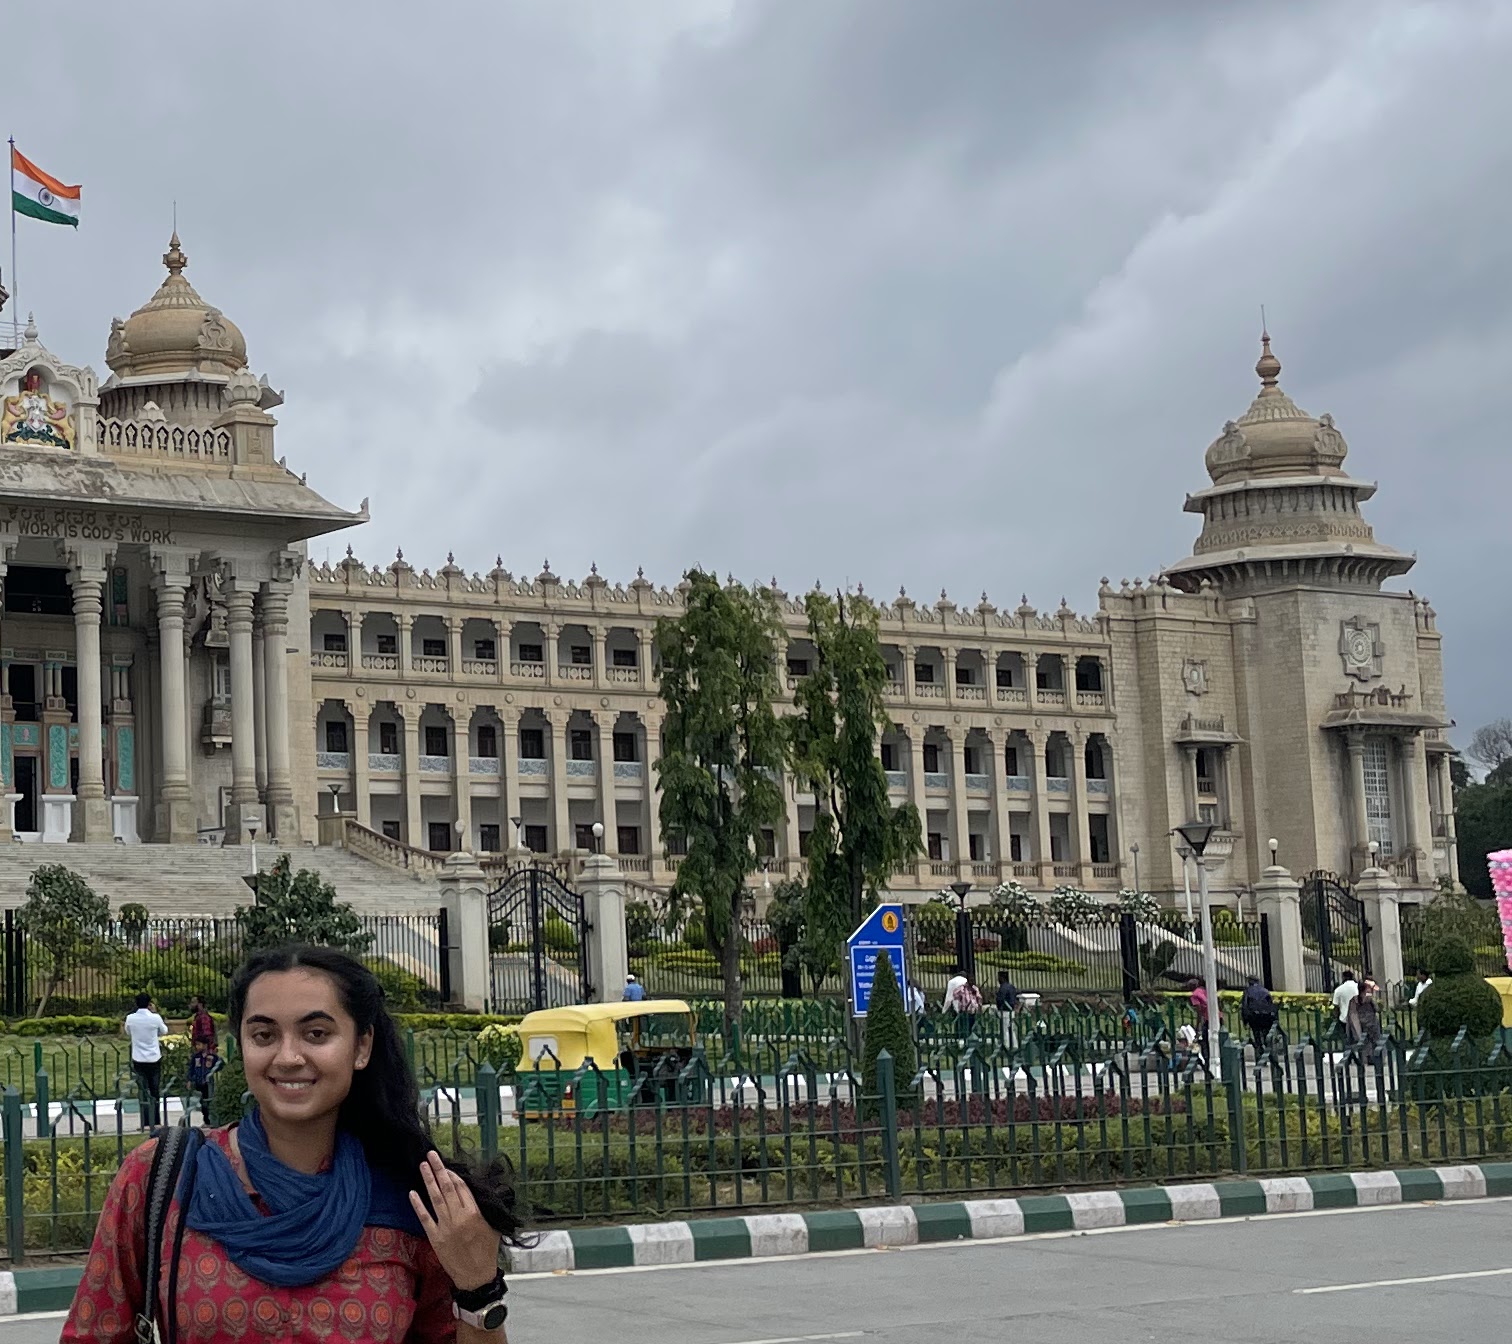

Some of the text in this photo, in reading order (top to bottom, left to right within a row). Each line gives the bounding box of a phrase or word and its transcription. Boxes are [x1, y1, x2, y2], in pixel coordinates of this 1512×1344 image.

[18, 520, 60, 537] WORK
[63, 523, 78, 538] IS
[130, 529, 177, 545] WORK.
